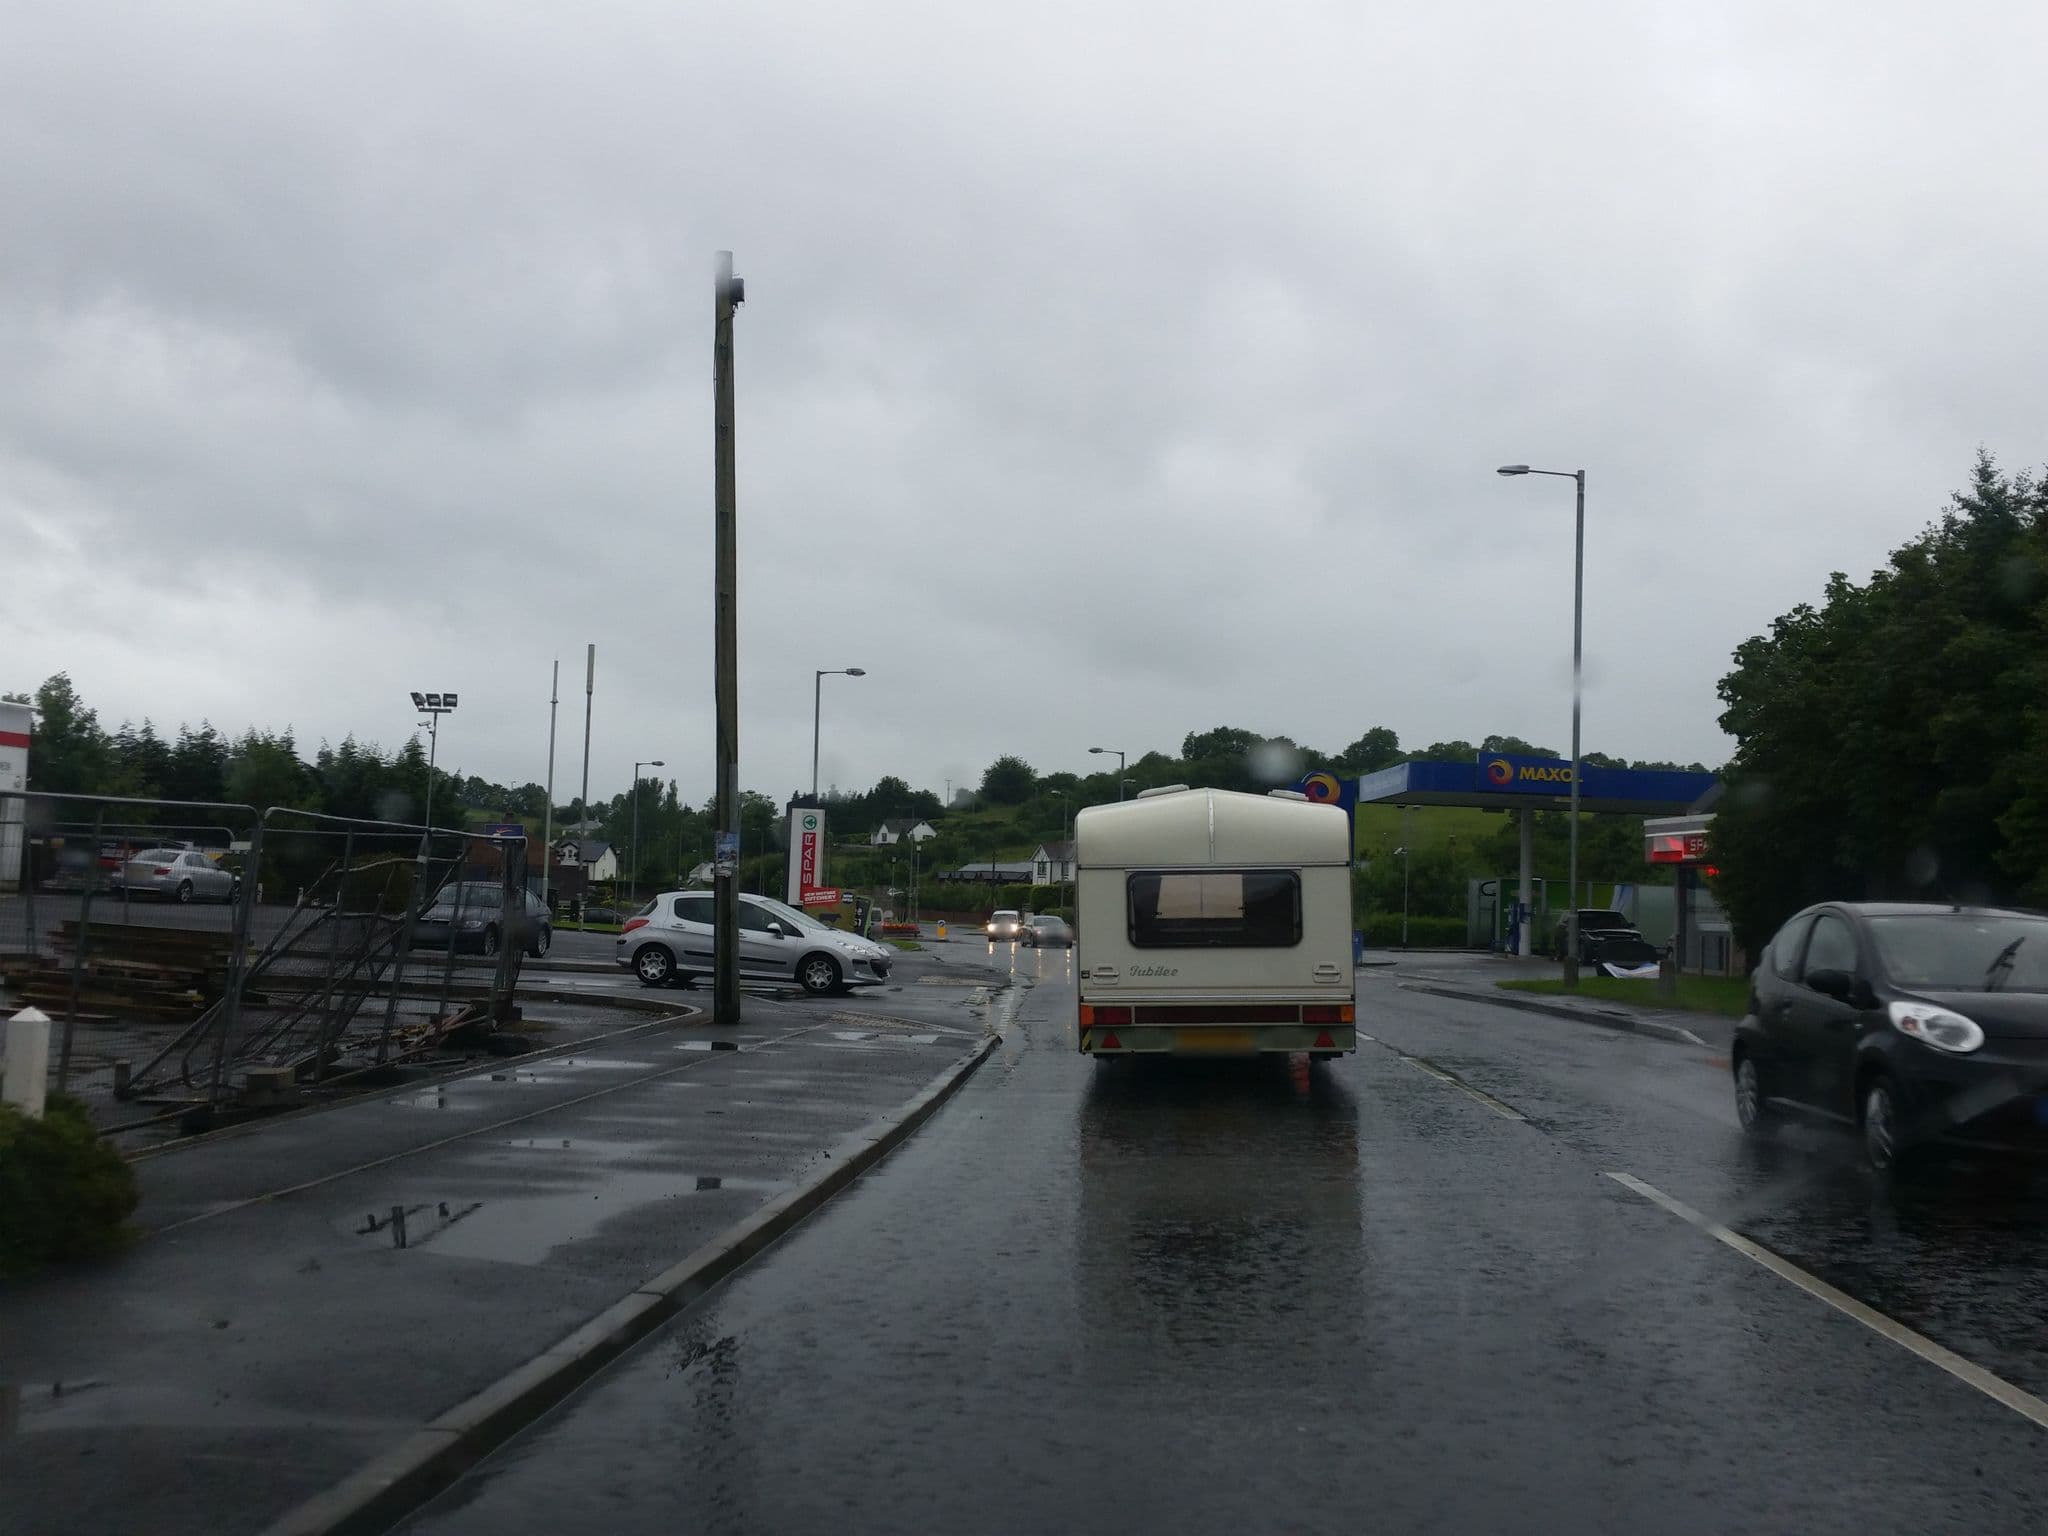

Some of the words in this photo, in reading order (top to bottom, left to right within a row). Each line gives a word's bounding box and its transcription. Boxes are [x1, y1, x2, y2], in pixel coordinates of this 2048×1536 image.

[1519, 766, 1584, 783] MAXO
[803, 834, 814, 884] SPAR
[1130, 965, 1178, 976] Jubilee
